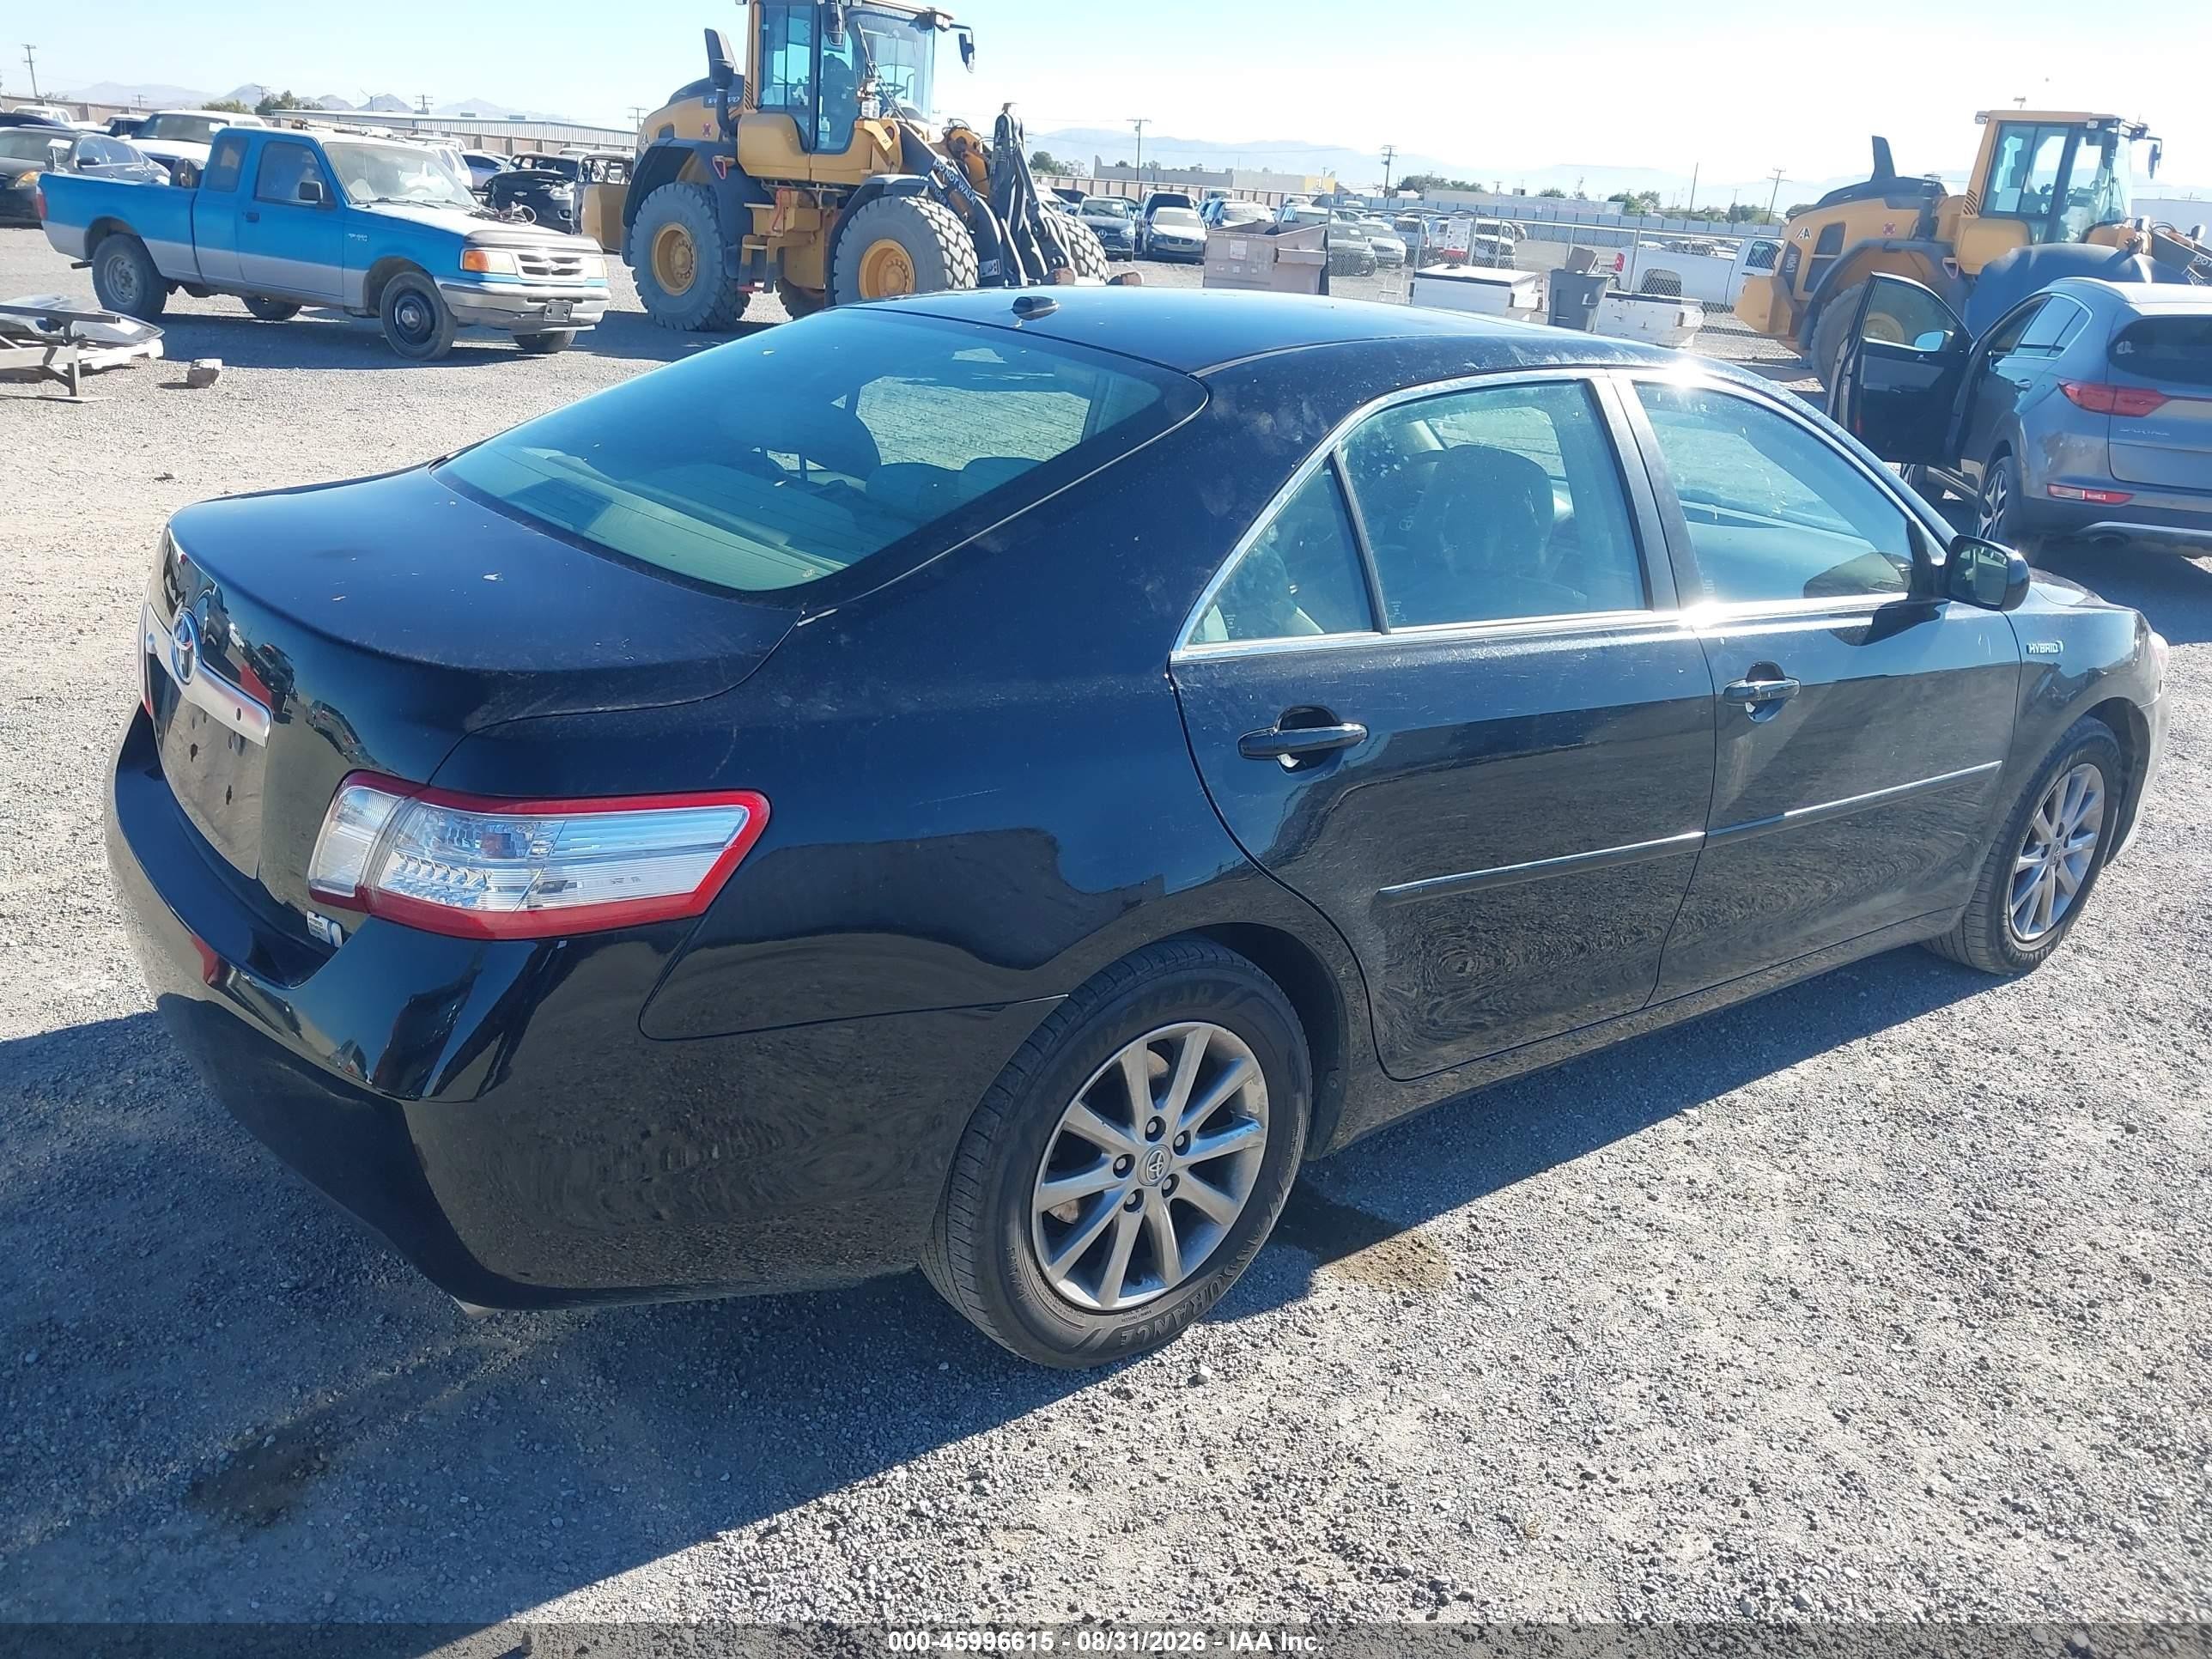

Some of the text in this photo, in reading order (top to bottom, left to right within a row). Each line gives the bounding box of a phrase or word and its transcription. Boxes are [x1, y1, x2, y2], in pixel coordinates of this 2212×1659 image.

[708, 95, 740, 104] VVO
[935, 160, 976, 204] DO NOT WALK
[2028, 642, 2059, 653] HYBRID
